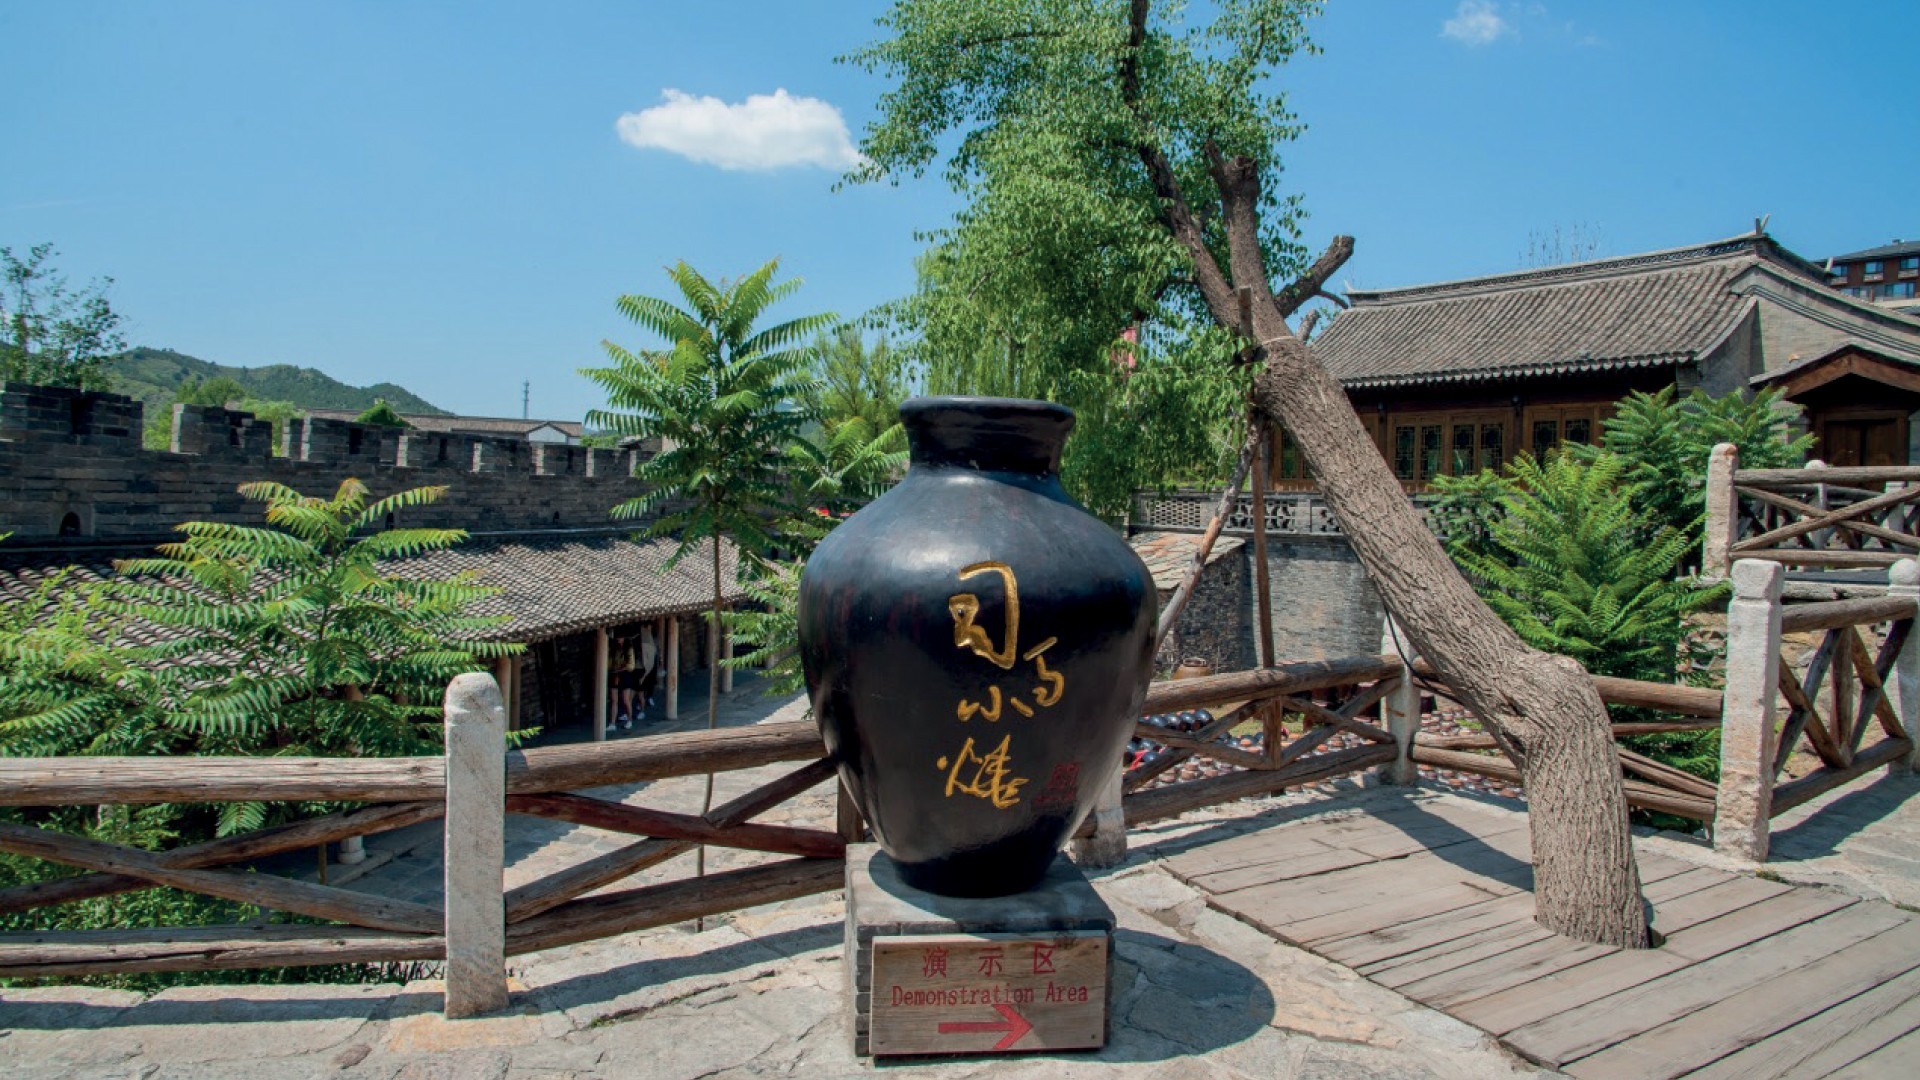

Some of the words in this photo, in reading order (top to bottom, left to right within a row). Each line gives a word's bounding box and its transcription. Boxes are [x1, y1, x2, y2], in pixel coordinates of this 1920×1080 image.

[922, 944, 1057, 978] 演示区
[891, 983, 1034, 1007] Demonstration
[1045, 981, 1089, 1002] Area
